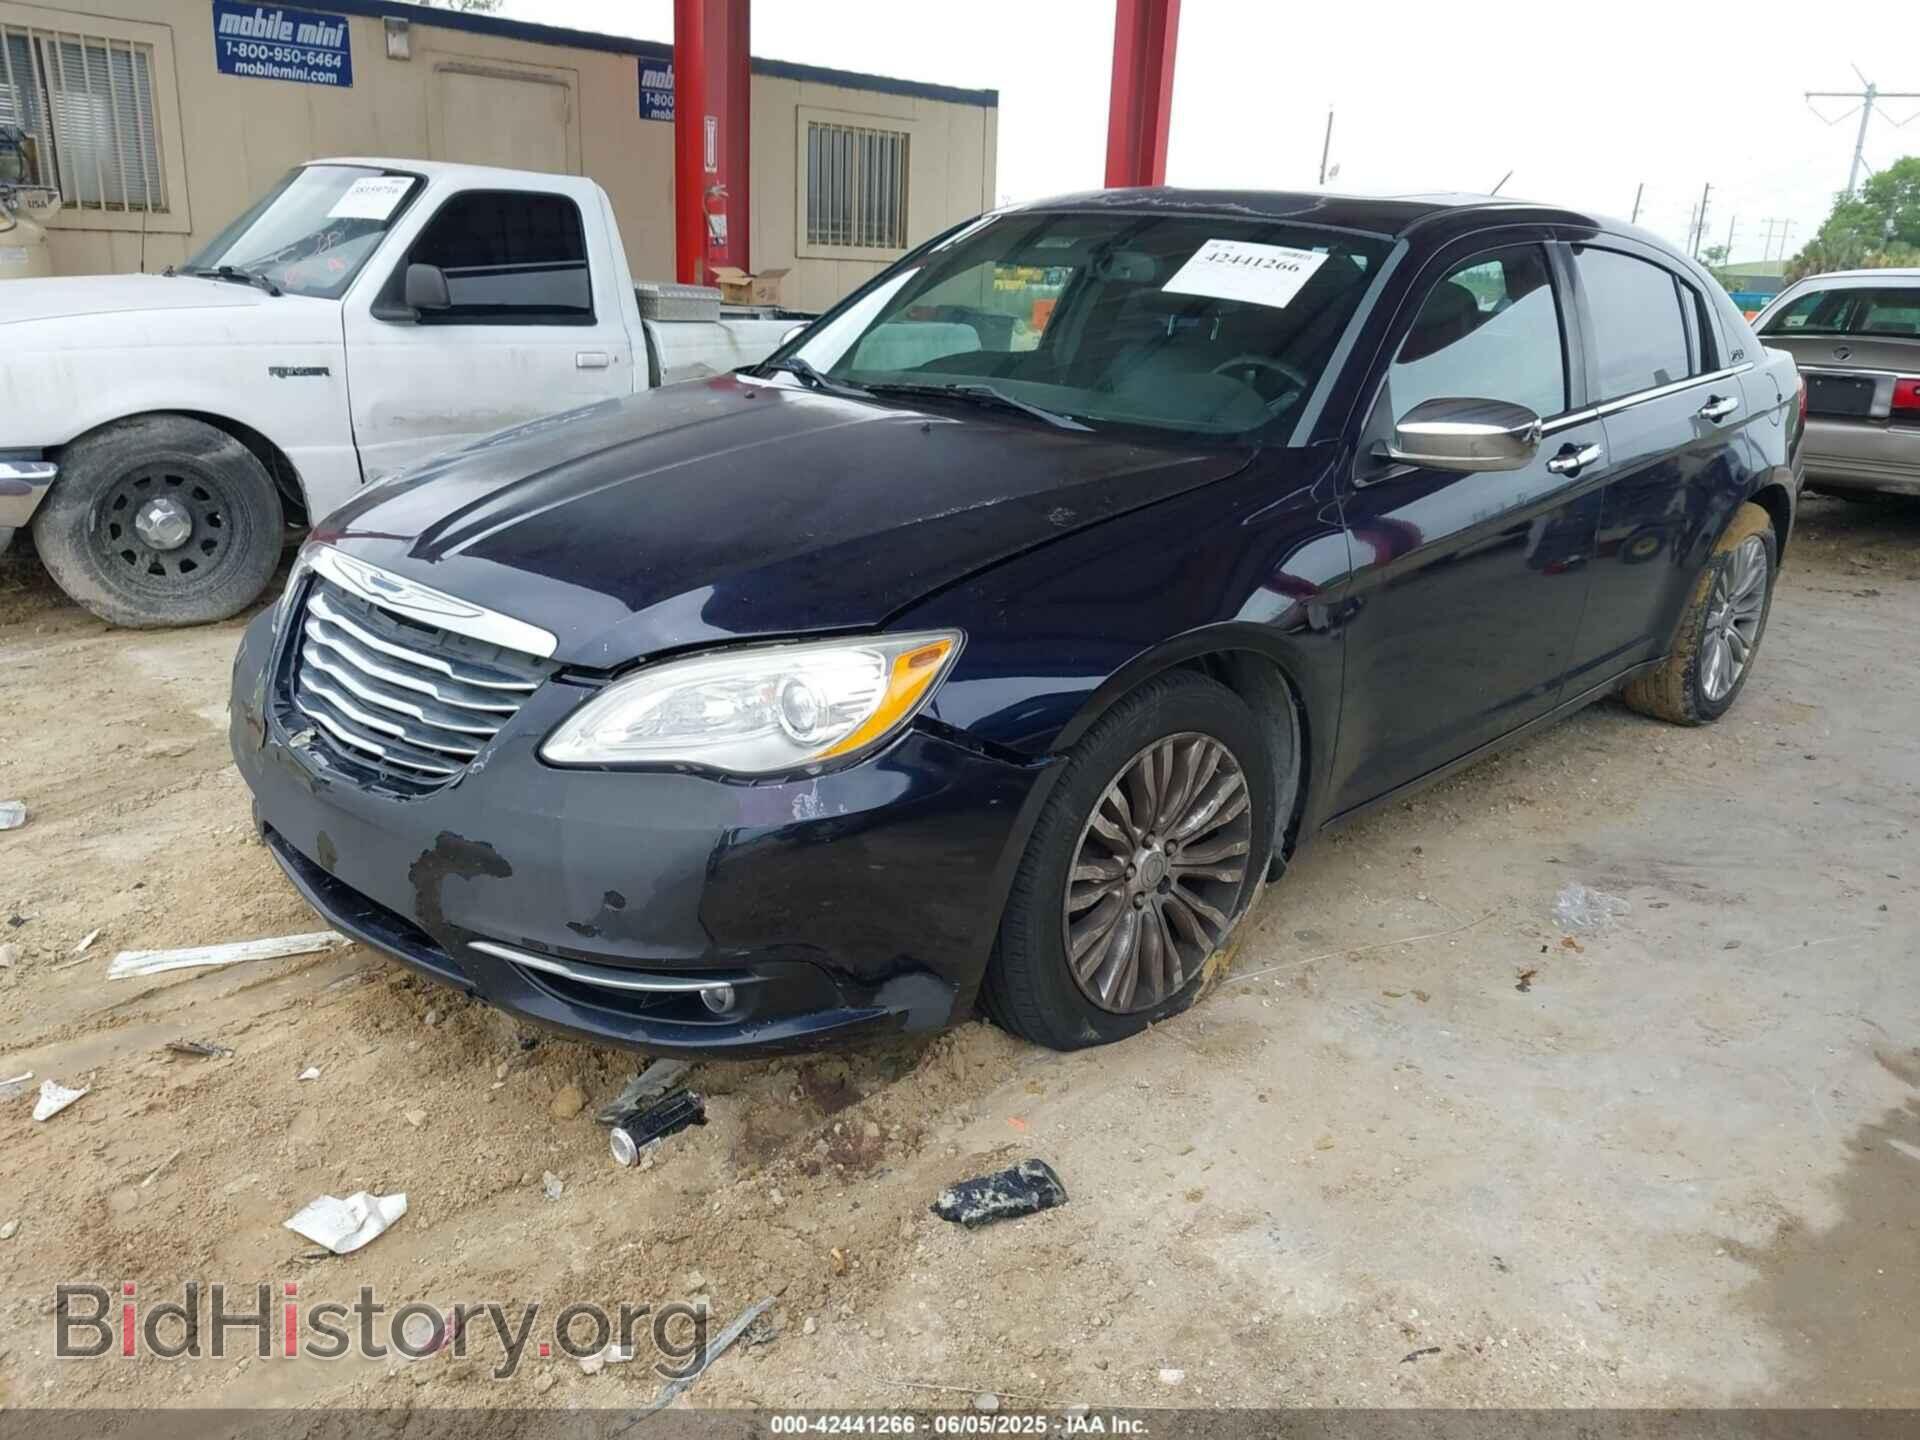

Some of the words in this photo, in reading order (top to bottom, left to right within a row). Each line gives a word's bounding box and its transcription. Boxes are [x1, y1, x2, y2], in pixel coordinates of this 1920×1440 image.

[219, 7, 294, 41] mobile
[296, 20, 344, 47] mini
[225, 41, 342, 68] 1-800-950-6464
[234, 61, 338, 83] mobilemini.com
[1205, 252, 1300, 273] 42441266
